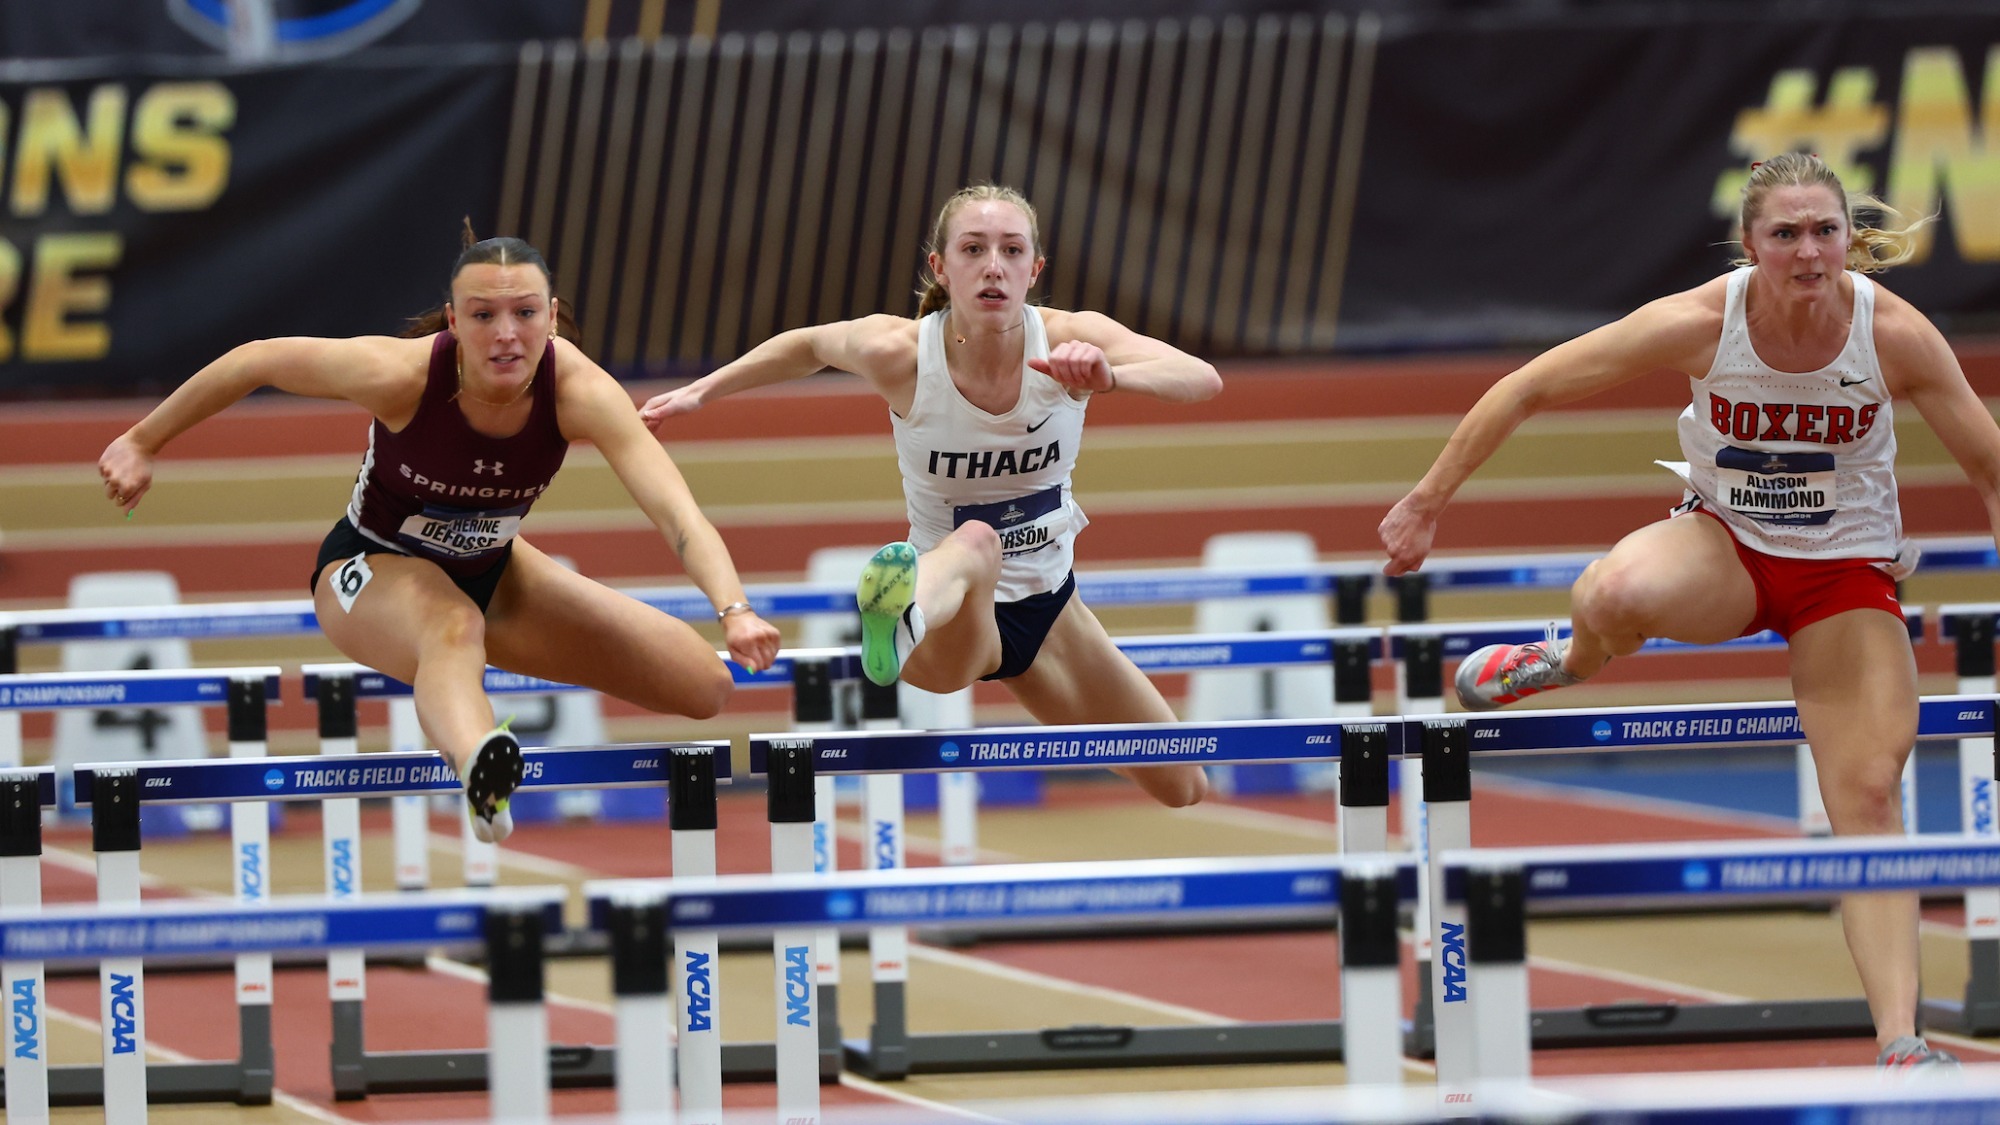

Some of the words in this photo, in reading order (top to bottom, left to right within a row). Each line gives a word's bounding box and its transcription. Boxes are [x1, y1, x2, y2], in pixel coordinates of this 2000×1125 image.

[0, 82, 237, 217] NS
[1709, 392, 1880, 444] BOXERS
[928, 439, 1061, 479] ITHACA
[399, 463, 556, 499] SPRINGFIEL
[1746, 474, 1807, 490] ALLYSON
[1730, 487, 1825, 509] HAMMOND
[340, 558, 363, 597] 6
[1958, 710, 1985, 721] GILL
[1474, 728, 1501, 739] GILL
[1622, 720, 1673, 738] TRACK
[1675, 719, 1687, 737] &
[1690, 717, 1731, 736] FIELD
[970, 742, 1021, 760] TRACK
[1023, 741, 1034, 759] &
[1037, 740, 1081, 758] FIELD
[1084, 737, 1218, 757] CHAMPIONSHIPS
[1305, 734, 1333, 745] GILL
[632, 759, 660, 769] GILL
[821, 748, 848, 758] GILL
[144, 777, 172, 788] GILL
[266, 778, 285, 786] NCAA
[294, 770, 347, 788] TRACK
[348, 769, 361, 786] &
[362, 767, 405, 786] FIELD
[1440, 921, 1467, 1003] NCAA
[686, 950, 712, 1032] NCAA
[785, 945, 811, 1028] NCAA
[13, 978, 39, 1061] NCAA
[110, 973, 137, 1055] NCAA
[1444, 1093, 1474, 1104] GILL
